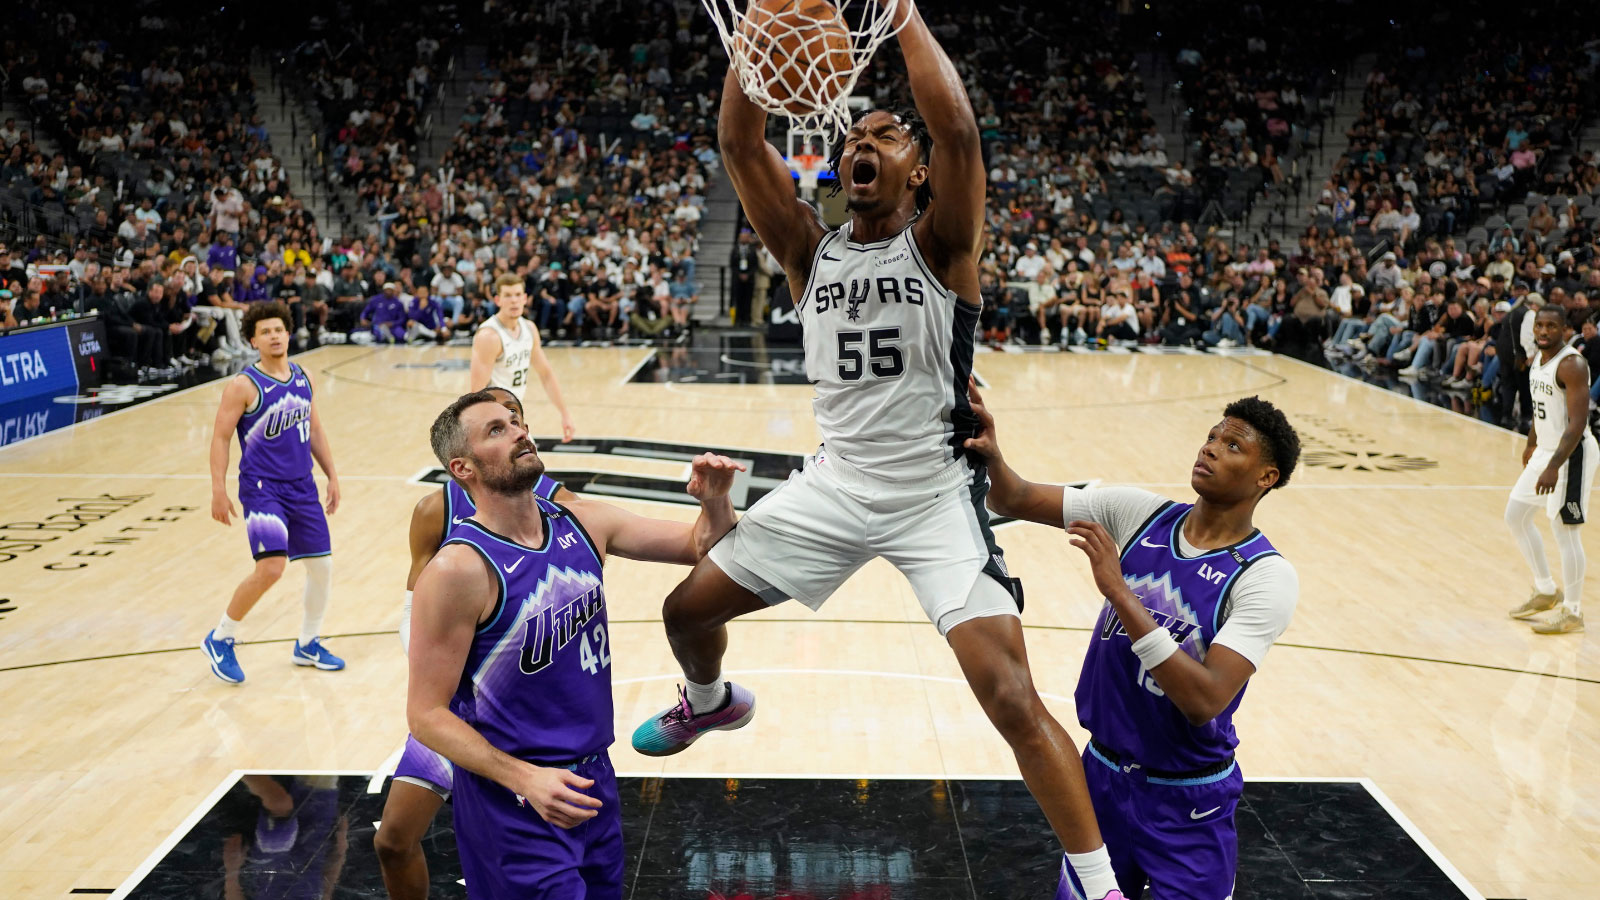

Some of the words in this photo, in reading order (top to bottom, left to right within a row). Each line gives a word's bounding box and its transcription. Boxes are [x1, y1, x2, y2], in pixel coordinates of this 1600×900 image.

[879, 253, 904, 265] LEDGER
[815, 277, 924, 321] SPURS
[79, 340, 101, 356] ULTRA
[836, 326, 906, 384] 55
[43, 506, 200, 571] CENTER
[557, 532, 578, 550] LVT
[1196, 562, 1228, 585] LVT
[519, 583, 604, 675] UTAH
[580, 623, 611, 676] 42
